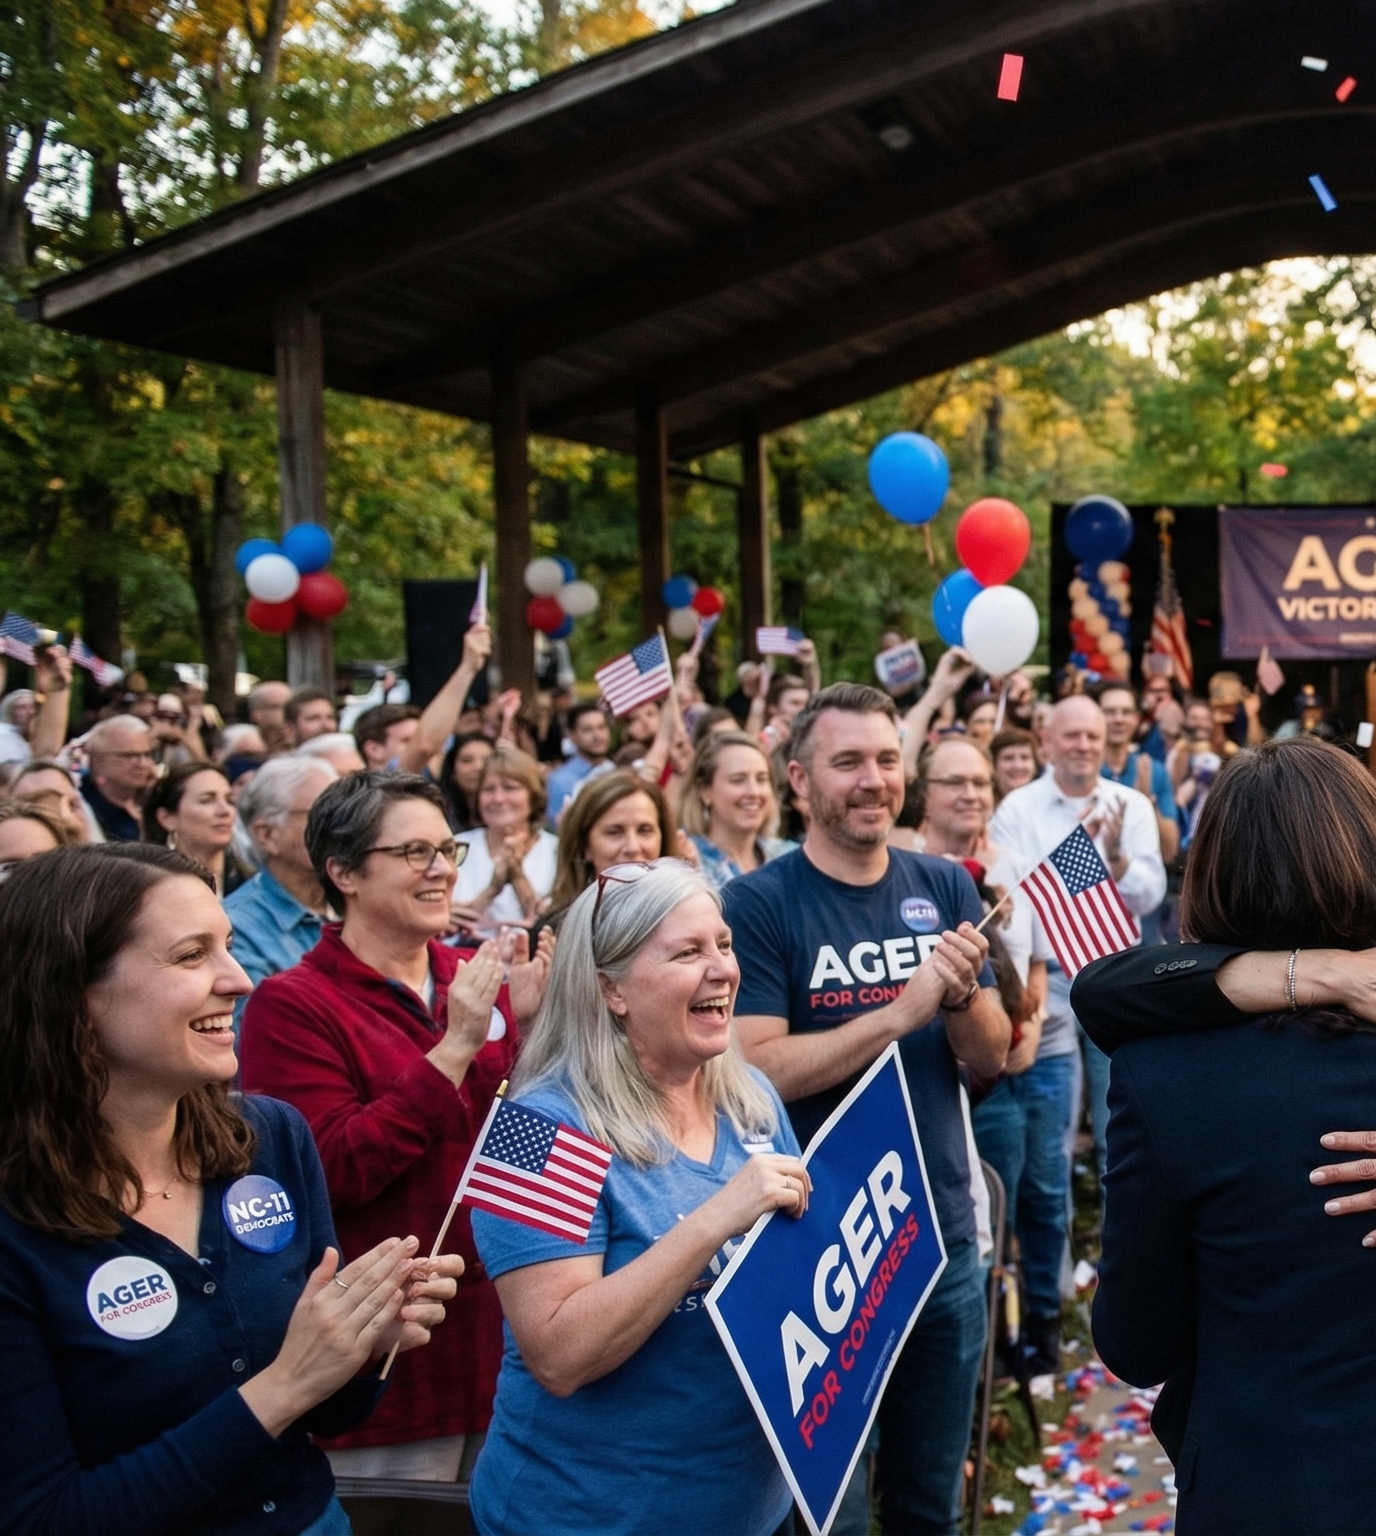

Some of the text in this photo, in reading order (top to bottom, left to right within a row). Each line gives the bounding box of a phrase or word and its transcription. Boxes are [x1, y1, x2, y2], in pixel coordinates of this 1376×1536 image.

[810, 991, 853, 1009] FOR
[228, 1191, 291, 1223] NC-11
[98, 1273, 168, 1314] AGER
[781, 1150, 911, 1418] AGER
[800, 1370, 842, 1449] FOR
[840, 1213, 919, 1371] CONGRESS
